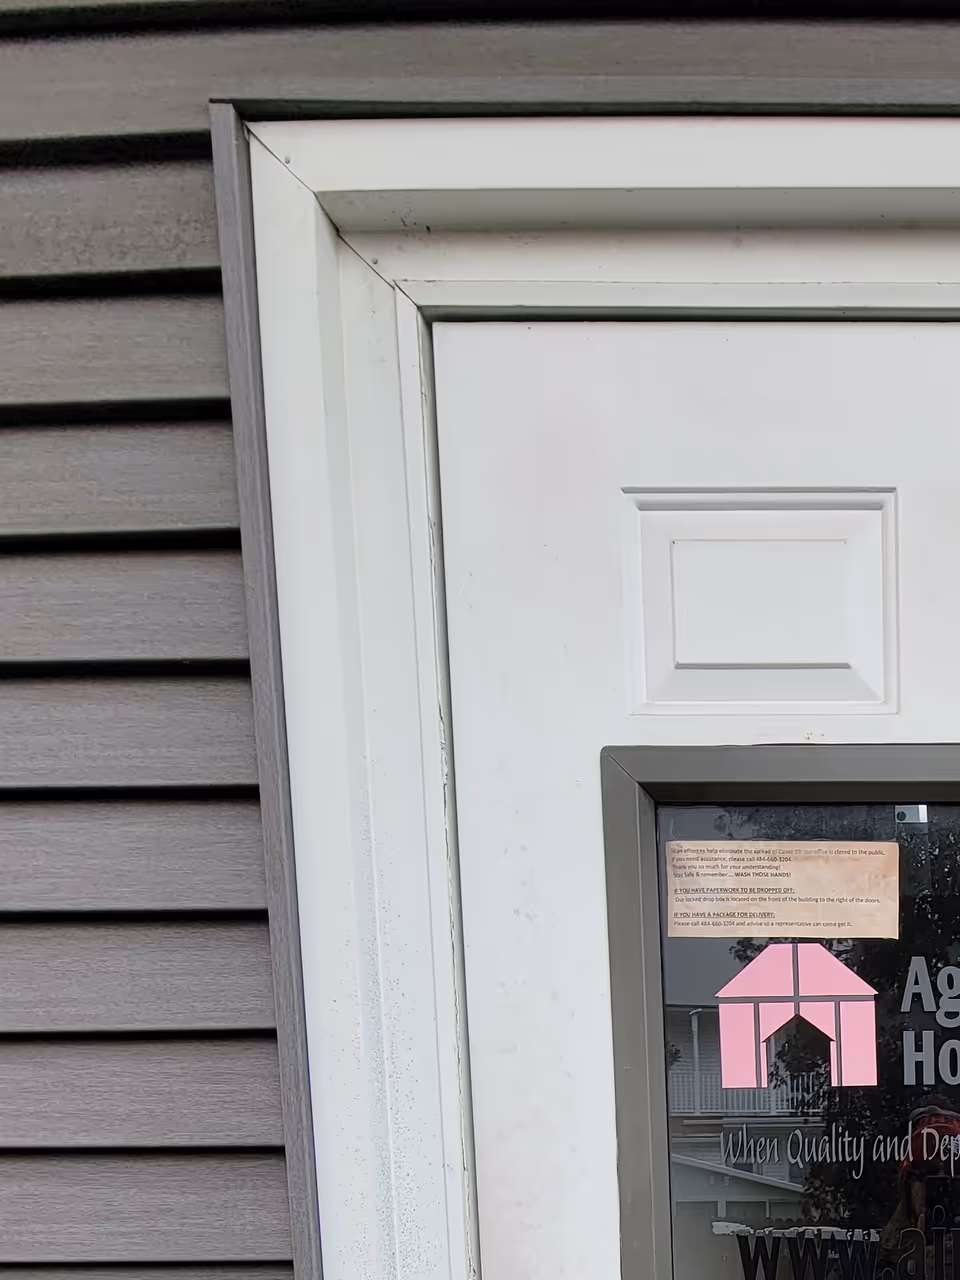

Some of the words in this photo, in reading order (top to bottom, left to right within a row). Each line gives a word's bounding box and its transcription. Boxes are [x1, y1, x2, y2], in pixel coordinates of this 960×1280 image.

[720, 1123, 780, 1165] When
[787, 1126, 865, 1179] Quality
[872, 1122, 913, 1162] and
